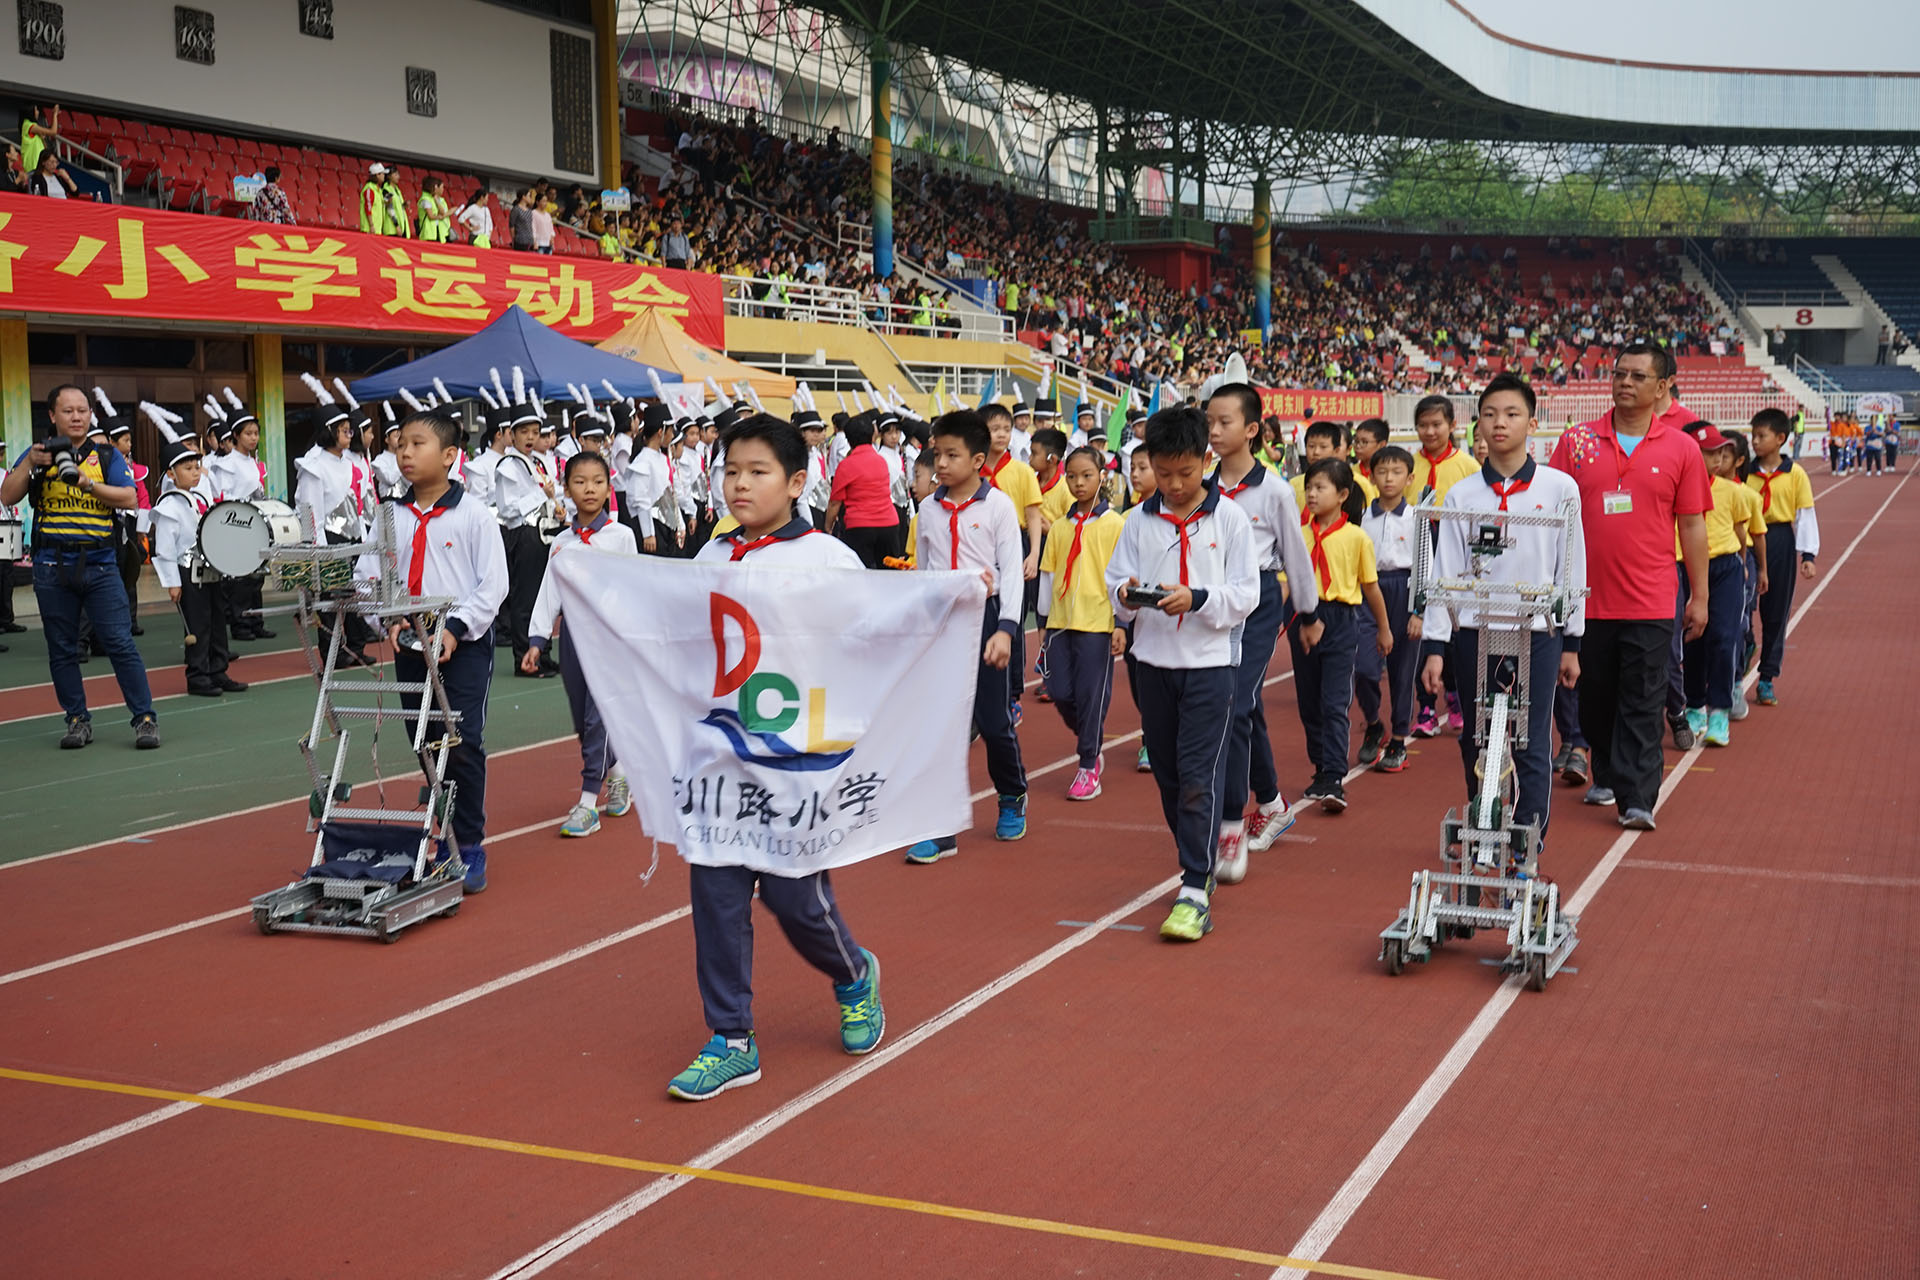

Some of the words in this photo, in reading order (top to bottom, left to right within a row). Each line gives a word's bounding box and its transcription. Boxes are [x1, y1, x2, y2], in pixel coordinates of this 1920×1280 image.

[24, 18, 65, 48] 1906
[180, 25, 215, 51] 1683
[0, 212, 690, 331] 小学运动会
[1795, 308, 1814, 326] 8
[1262, 393, 1304, 416] 文明东川
[221, 510, 254, 527] Pearl
